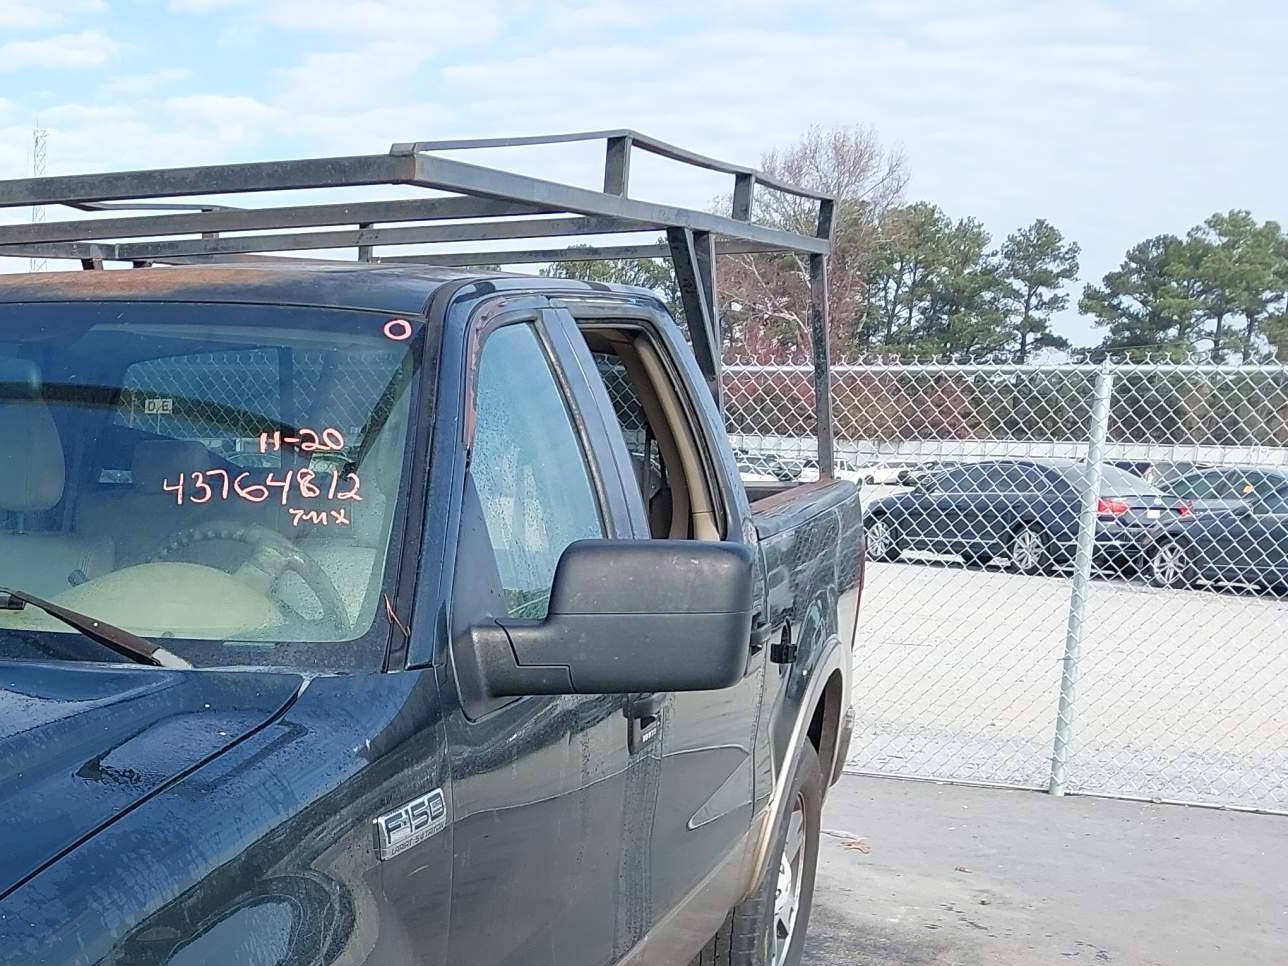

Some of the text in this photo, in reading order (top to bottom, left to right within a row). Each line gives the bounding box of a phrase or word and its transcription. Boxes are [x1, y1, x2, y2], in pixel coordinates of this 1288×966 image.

[259, 428, 345, 453] 11-20
[163, 468, 364, 505] 43764812
[383, 790, 445, 845] F-150
